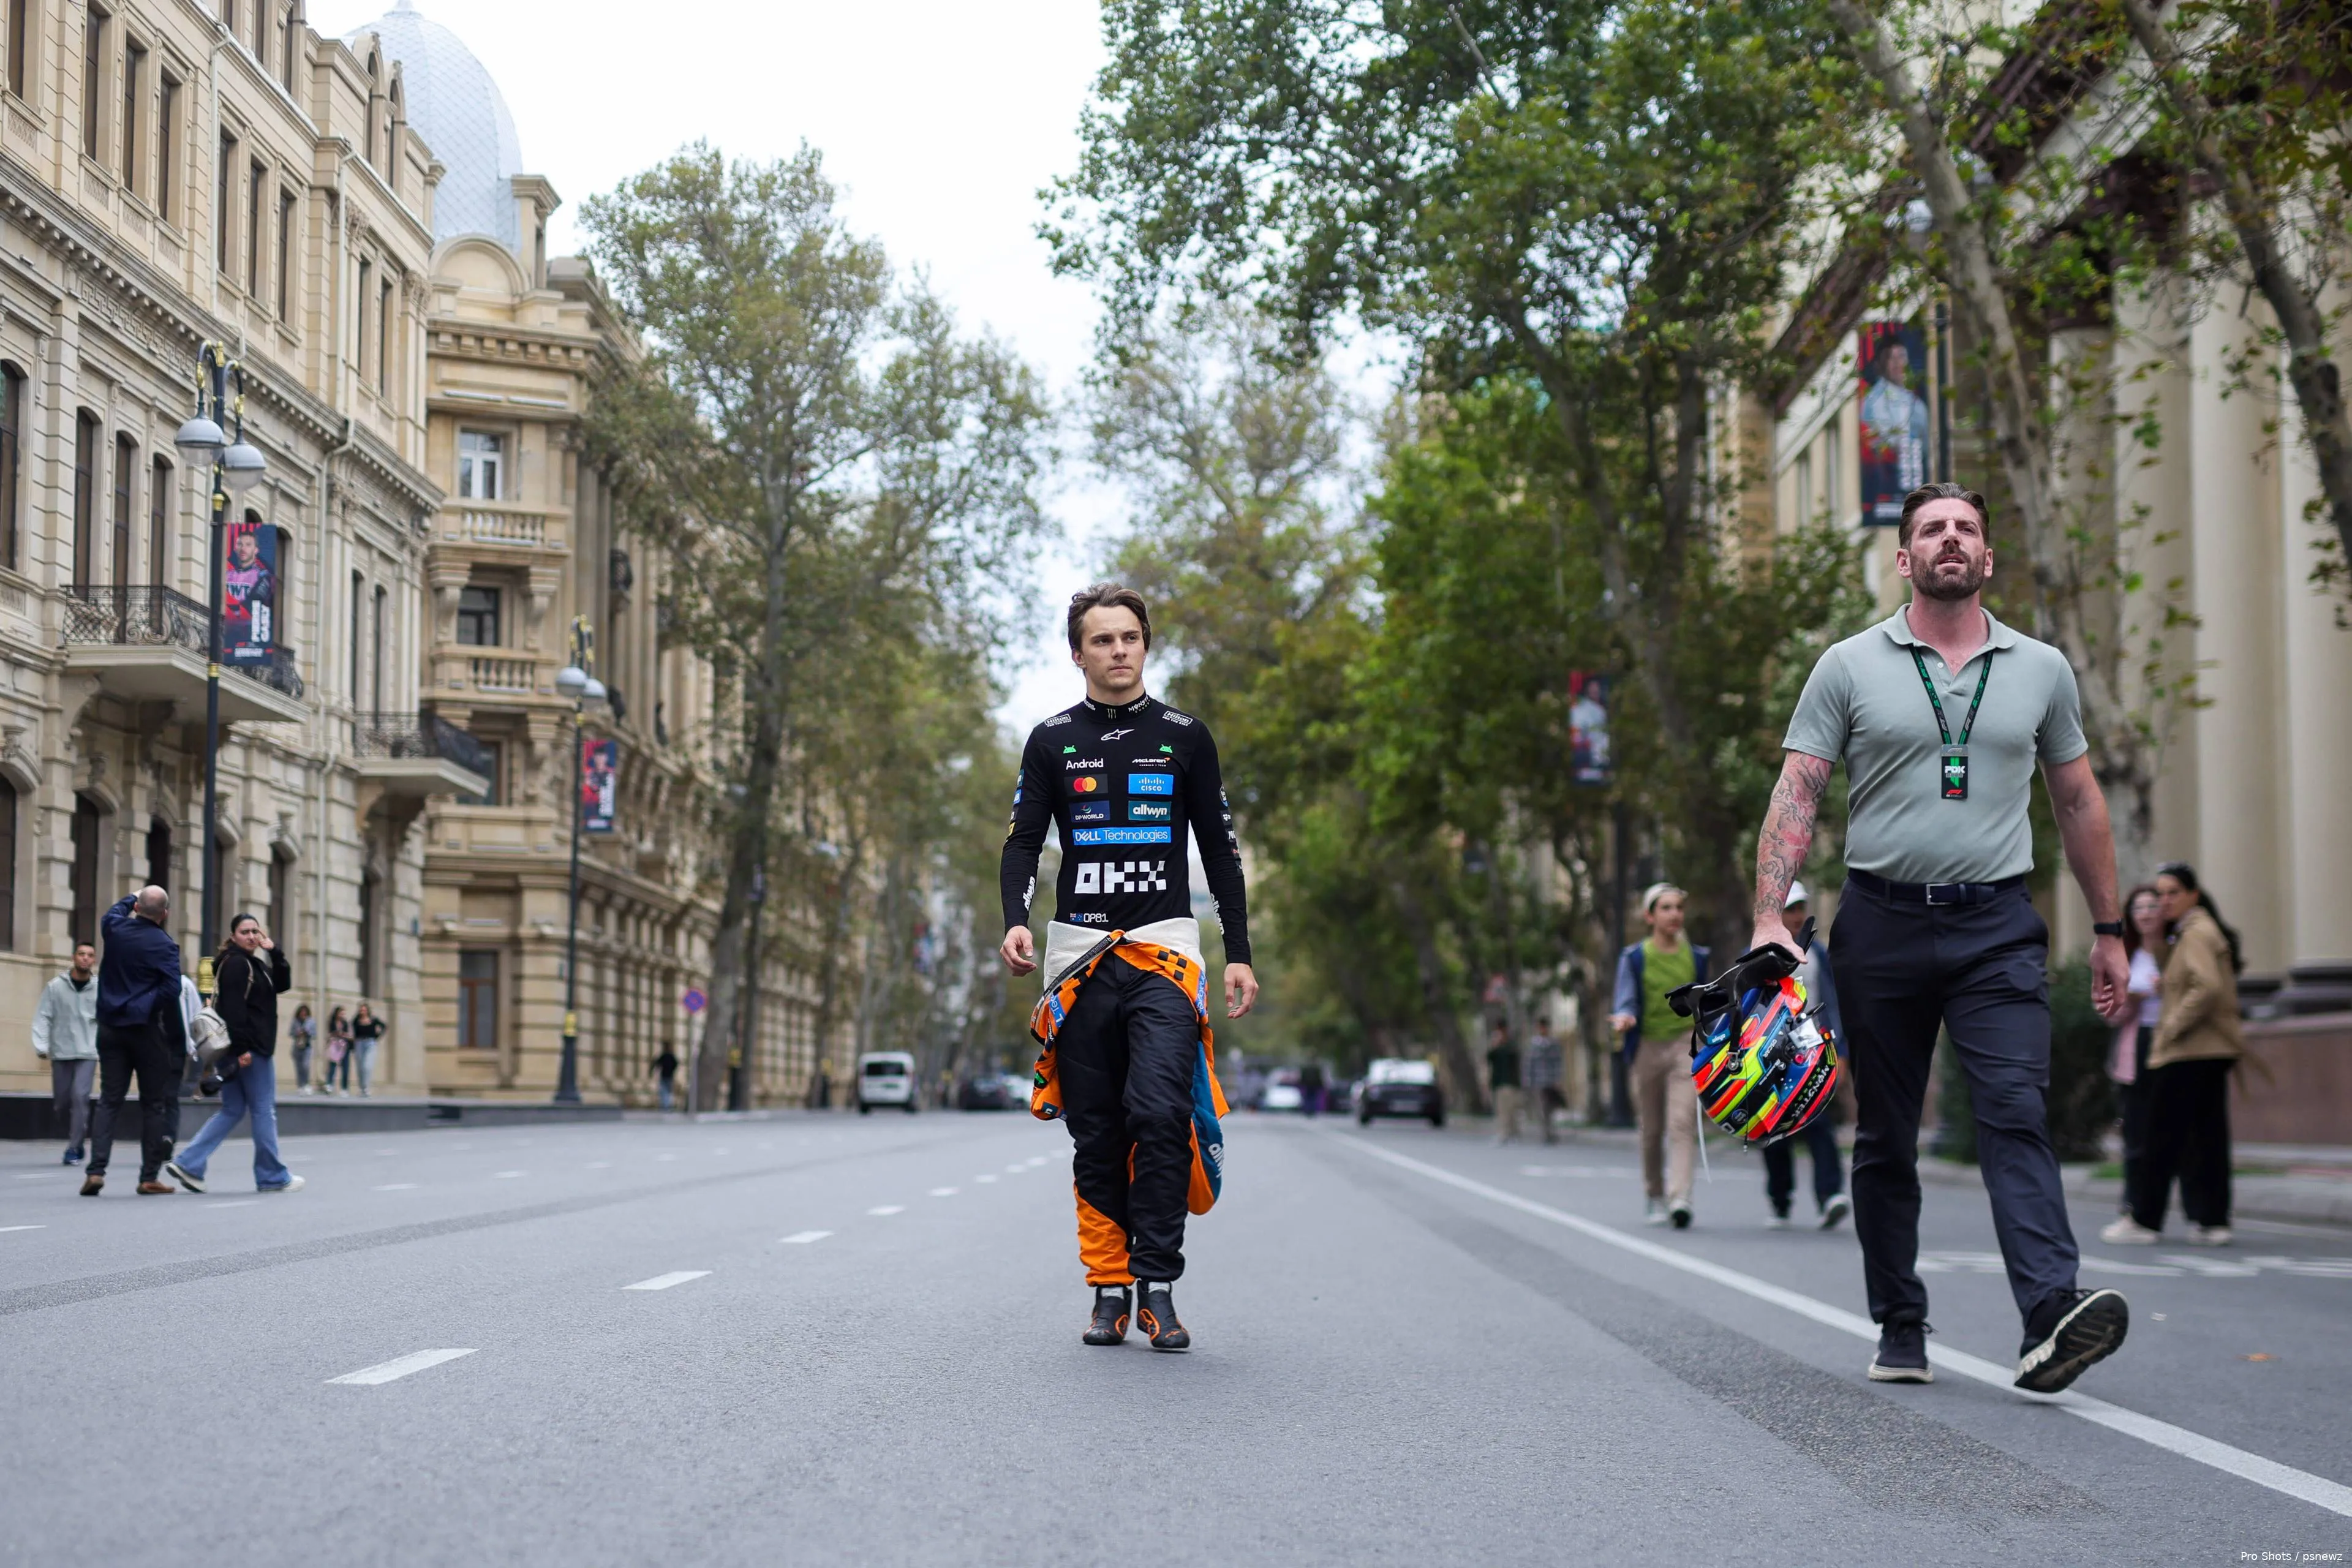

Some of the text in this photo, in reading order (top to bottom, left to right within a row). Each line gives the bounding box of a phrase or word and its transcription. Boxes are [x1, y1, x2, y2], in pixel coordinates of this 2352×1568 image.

[1047, 715, 1069, 725] Hilton
[1166, 711, 1189, 723] Hilton
[1066, 758, 1104, 770] Android
[1133, 804, 1167, 818] allwyn
[1075, 830, 1168, 842] DELL Technologies
[1074, 861, 1167, 894] OKX
[1084, 913, 1109, 922] OP81
[1763, 1039, 1777, 1058] OSCAR
